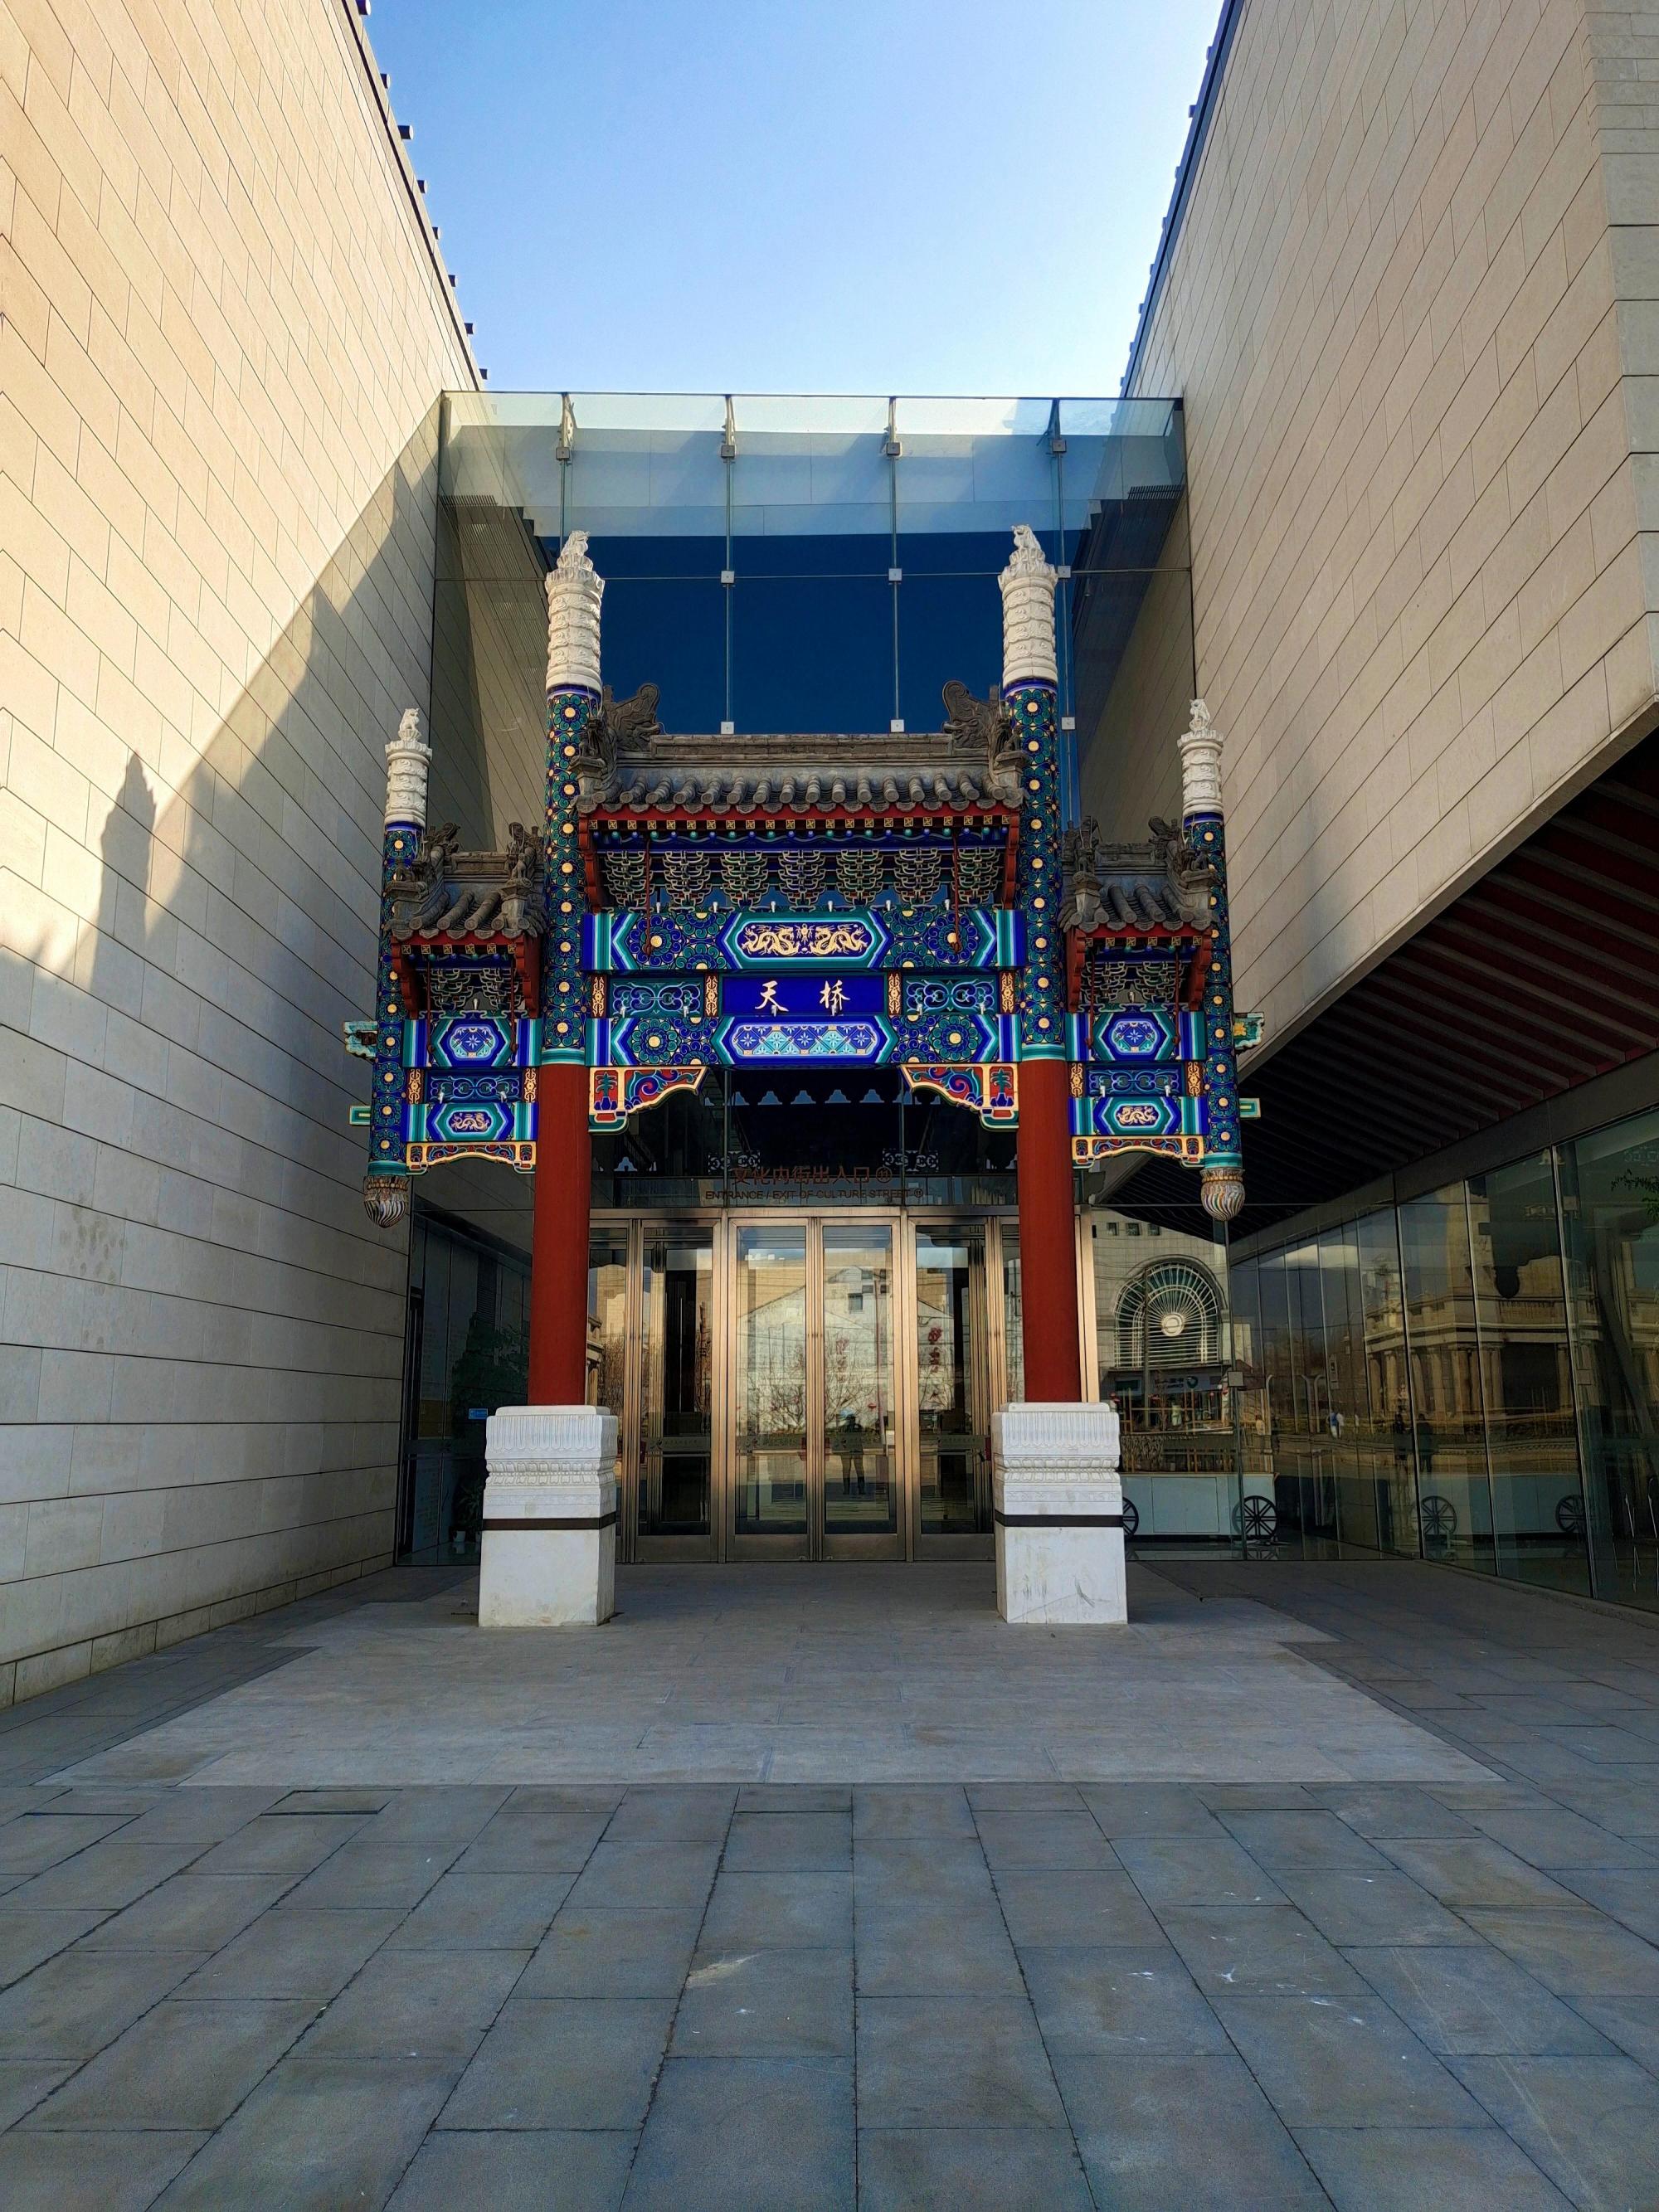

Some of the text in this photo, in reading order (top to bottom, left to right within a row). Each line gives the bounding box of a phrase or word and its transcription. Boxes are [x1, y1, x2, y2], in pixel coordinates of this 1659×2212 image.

[755, 980, 850, 1012] 天桥
[732, 1164, 869, 1185] 文化内街出入口
[705, 1190, 764, 1199] ENTRANCE
[772, 1190, 797, 1199] EXIT
[800, 1190, 814, 1199] OF
[815, 1189, 867, 1198] CULTURE
[868, 1189, 912, 1198] STREET
